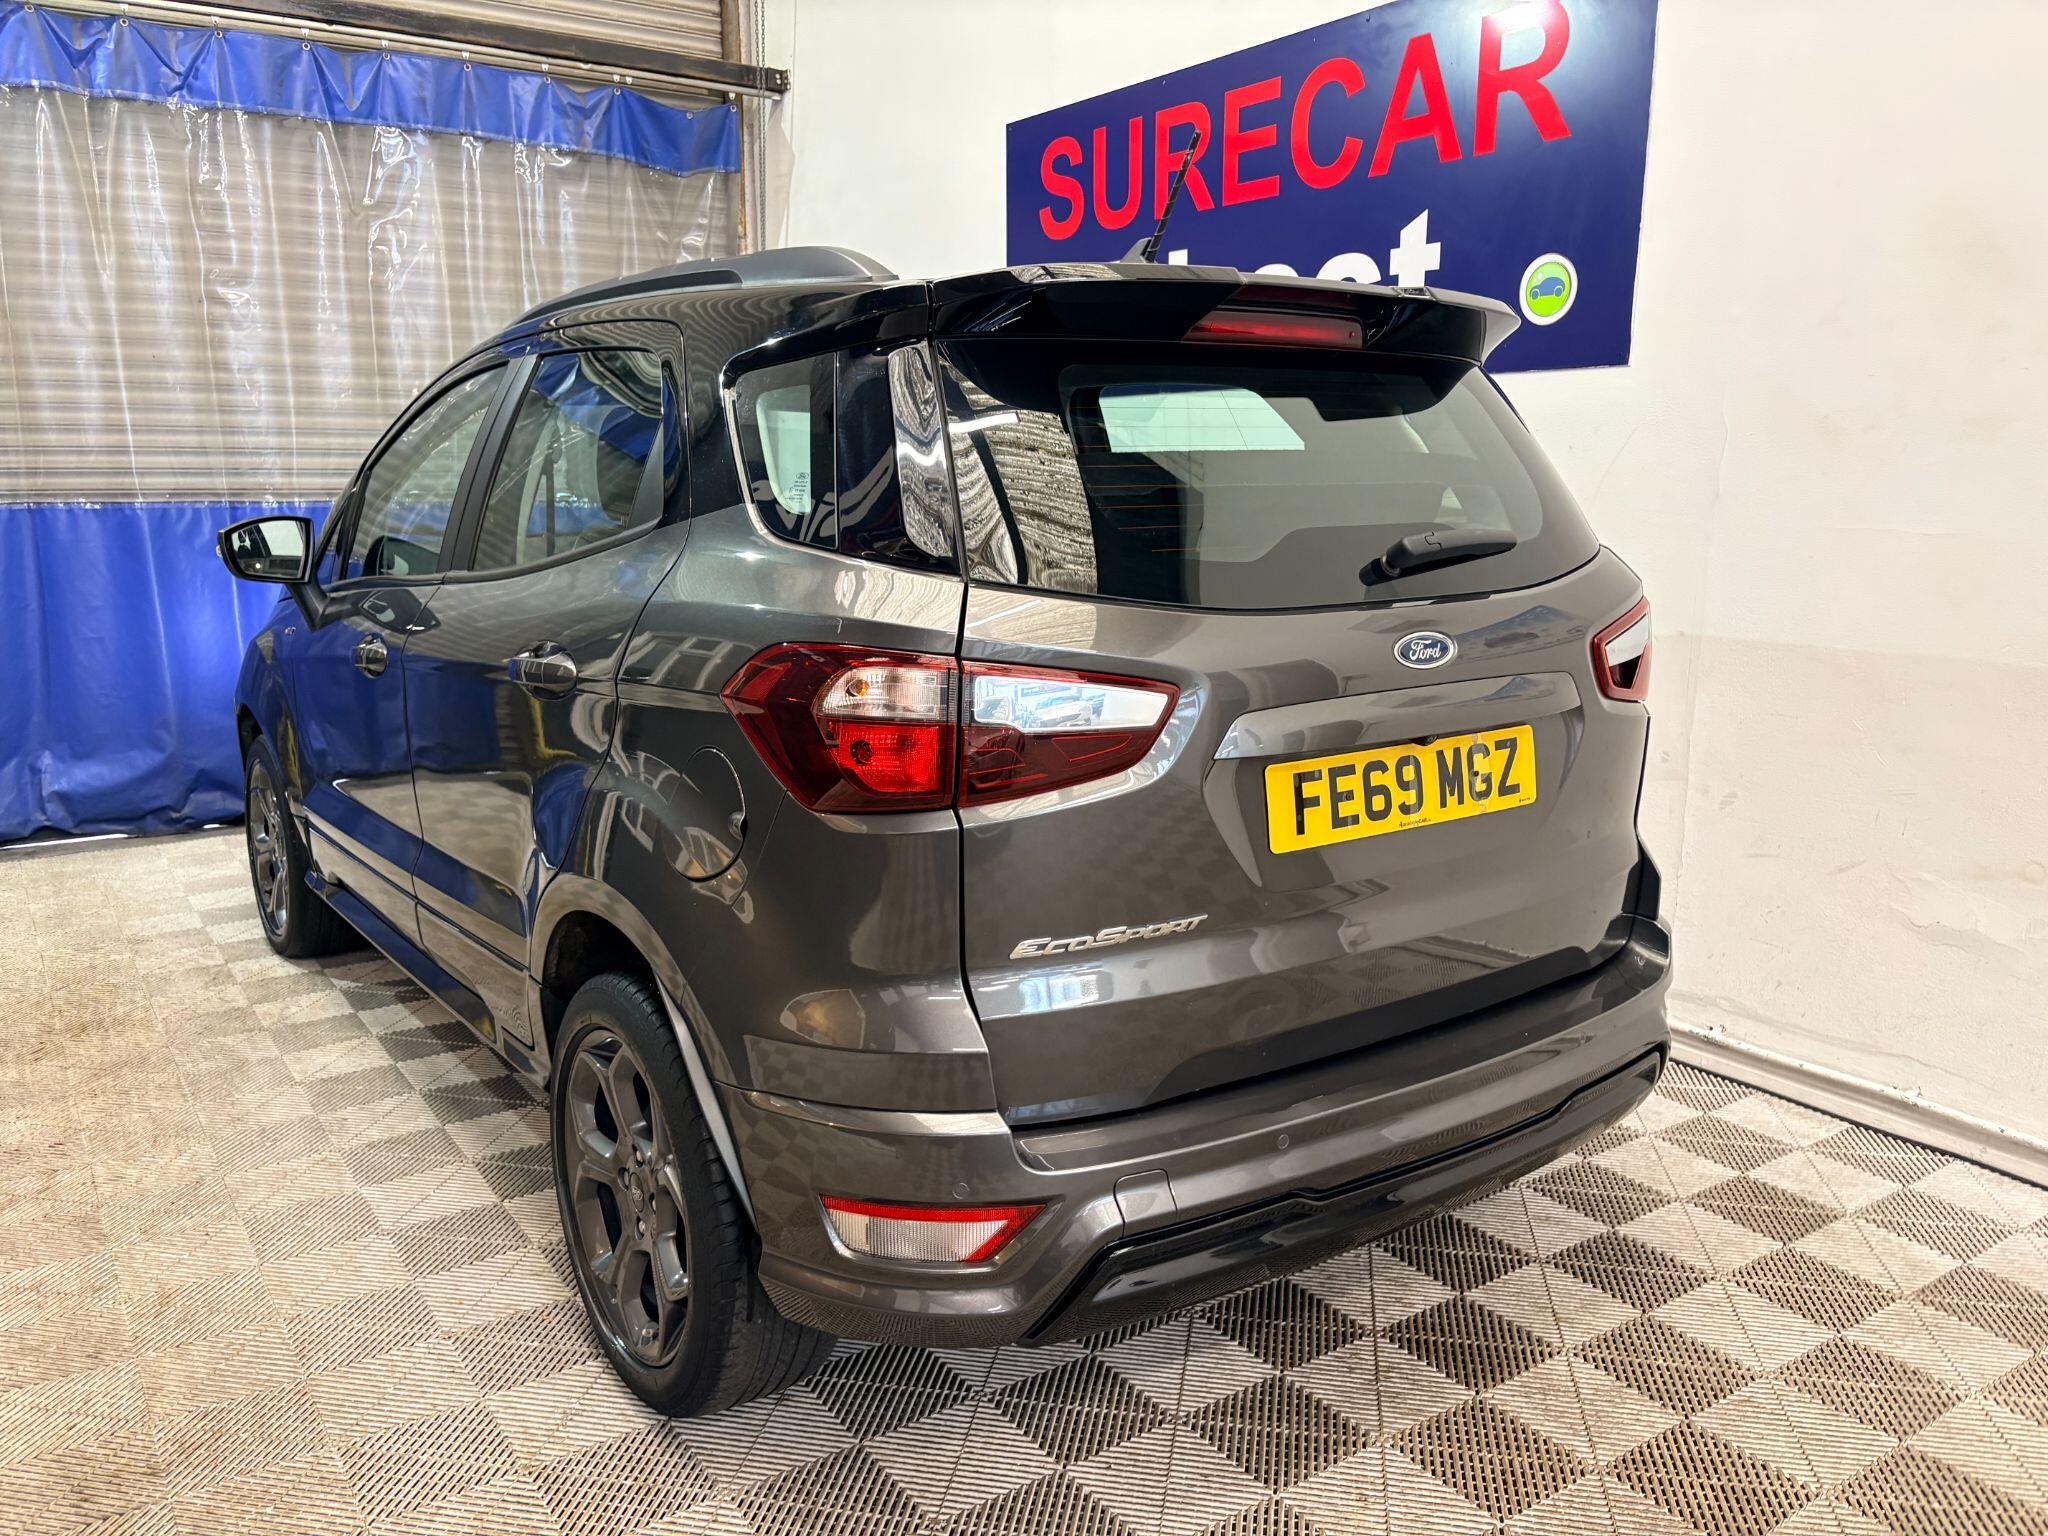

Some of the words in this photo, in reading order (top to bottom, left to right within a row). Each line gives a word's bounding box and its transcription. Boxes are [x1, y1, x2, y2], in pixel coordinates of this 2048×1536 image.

[1039, 0, 1572, 240] SURECAR
[1409, 639, 1442, 661] Ford
[1293, 755, 1424, 837] FE69
[1436, 737, 1521, 809] MGZ
